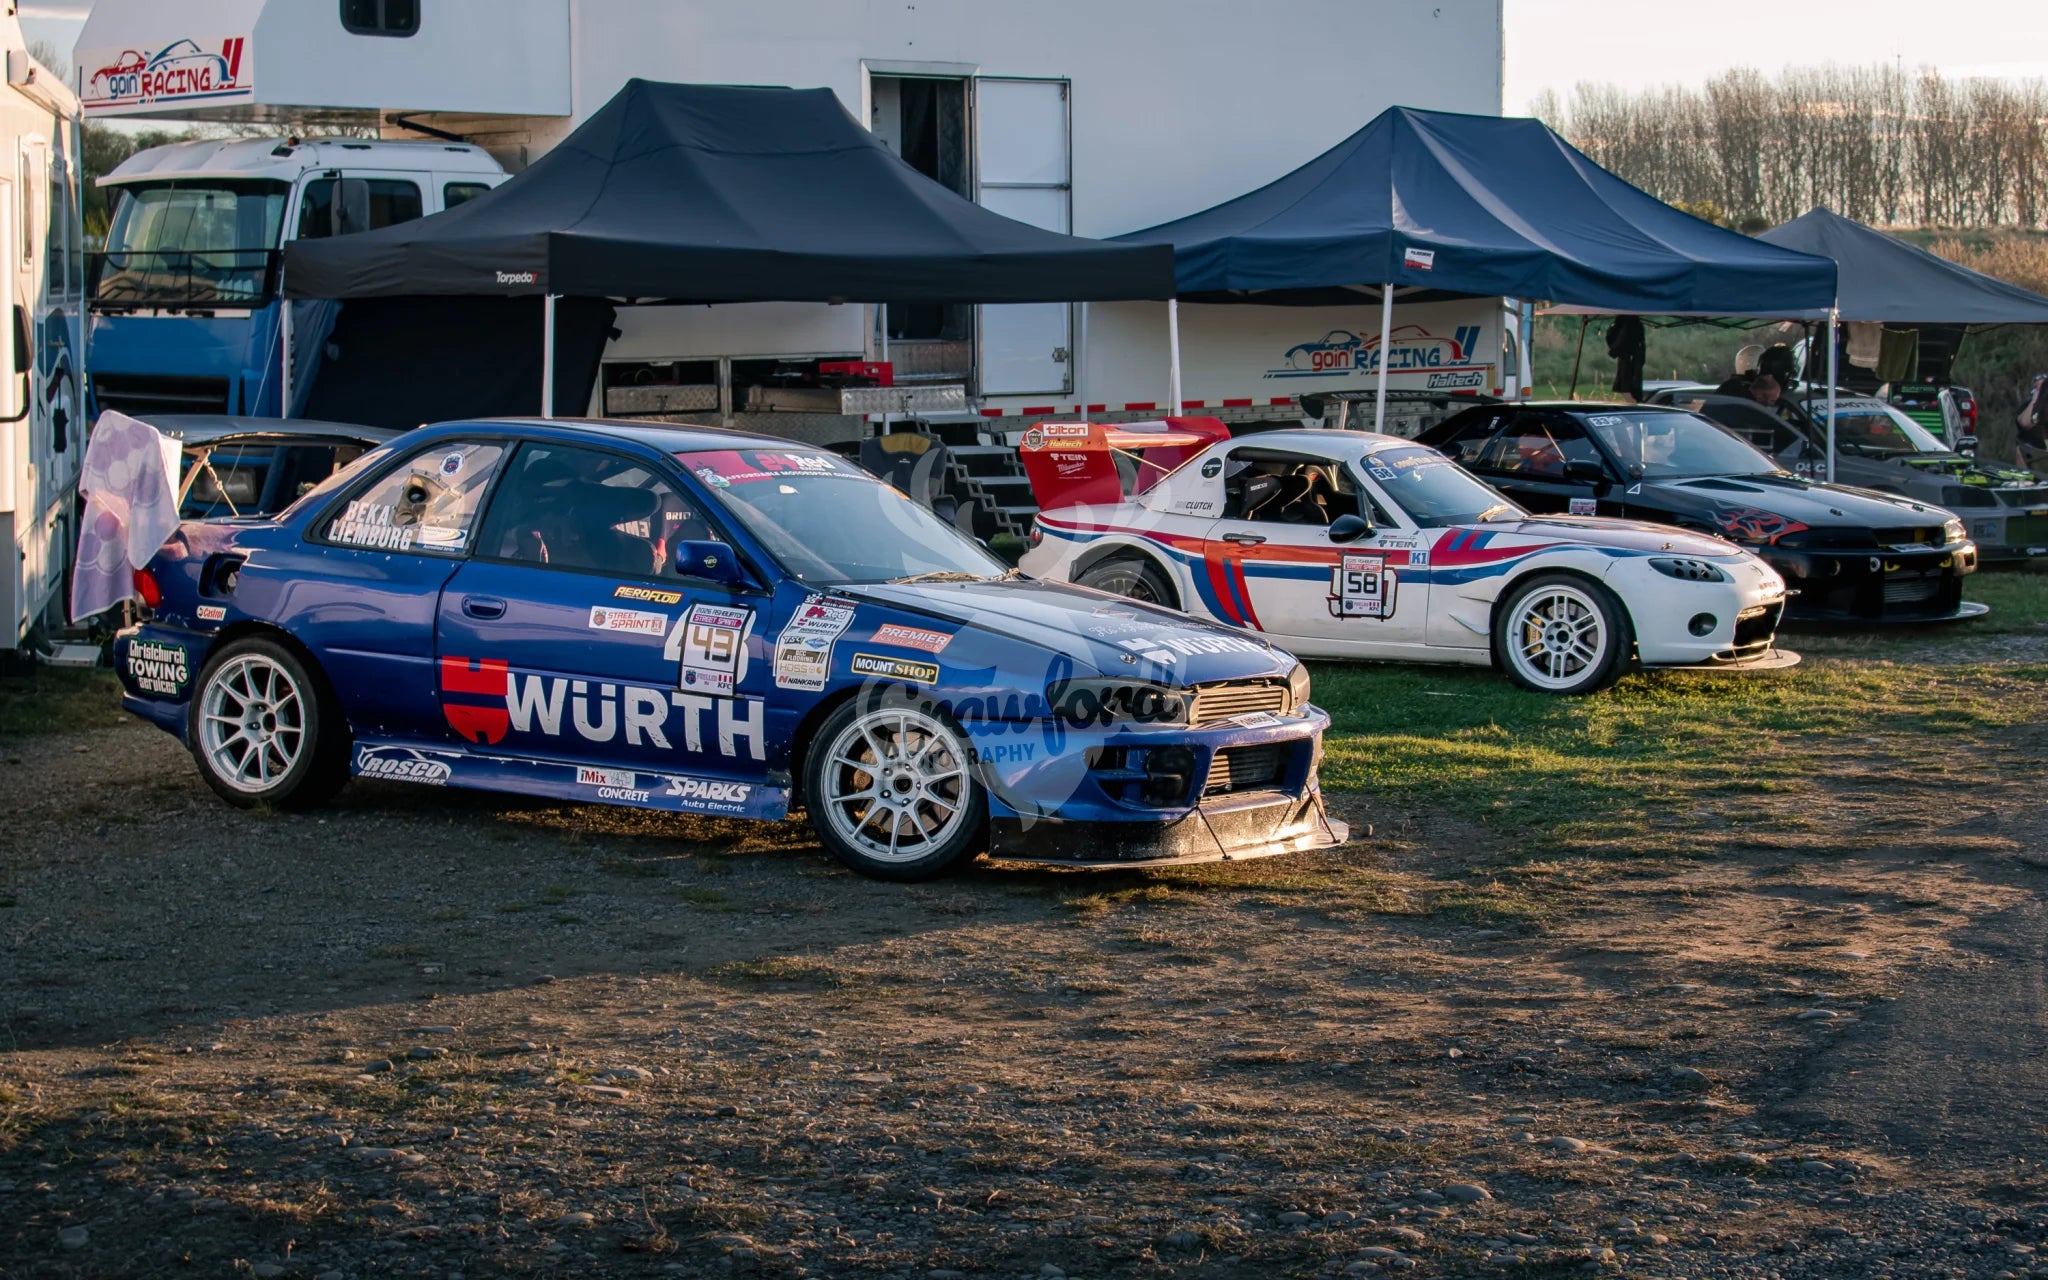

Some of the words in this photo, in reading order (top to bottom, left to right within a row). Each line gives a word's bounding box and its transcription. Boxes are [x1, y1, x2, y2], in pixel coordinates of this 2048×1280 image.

[141, 67, 210, 96] RACING
[1427, 373, 1482, 388] Haltech
[1046, 425, 1086, 435] tilton
[1373, 468, 1394, 479] 58
[345, 500, 390, 526] BEKA
[1185, 501, 1213, 510] CLUTCH
[328, 519, 414, 550] LIEMBURG
[1389, 540, 1417, 548] TEIN
[1411, 552, 1428, 565] K1
[1347, 572, 1378, 594] 58
[614, 586, 682, 604] AEROFLOW
[203, 608, 223, 619] Castrol
[608, 612, 638, 620] STREET
[694, 614, 717, 624] STREET
[718, 618, 738, 627] SPRINT
[611, 620, 650, 629] SPRINT
[880, 627, 948, 645] PREMIER
[693, 626, 734, 662] 43
[128, 658, 188, 683] TOWING
[856, 658, 895, 673] MOUNT
[894, 664, 935, 679] SHOP
[717, 682, 732, 690] KFC
[788, 677, 823, 687] NANKANG
[364, 758, 444, 778] ROSCO
[359, 771, 382, 779] AUTO
[383, 773, 446, 786] DISMANTLERS
[580, 769, 606, 784] iMix
[597, 786, 650, 803] CONCRETE
[665, 776, 751, 802] SPARKS
[681, 799, 705, 809] Auto
[707, 802, 746, 813] Electric
